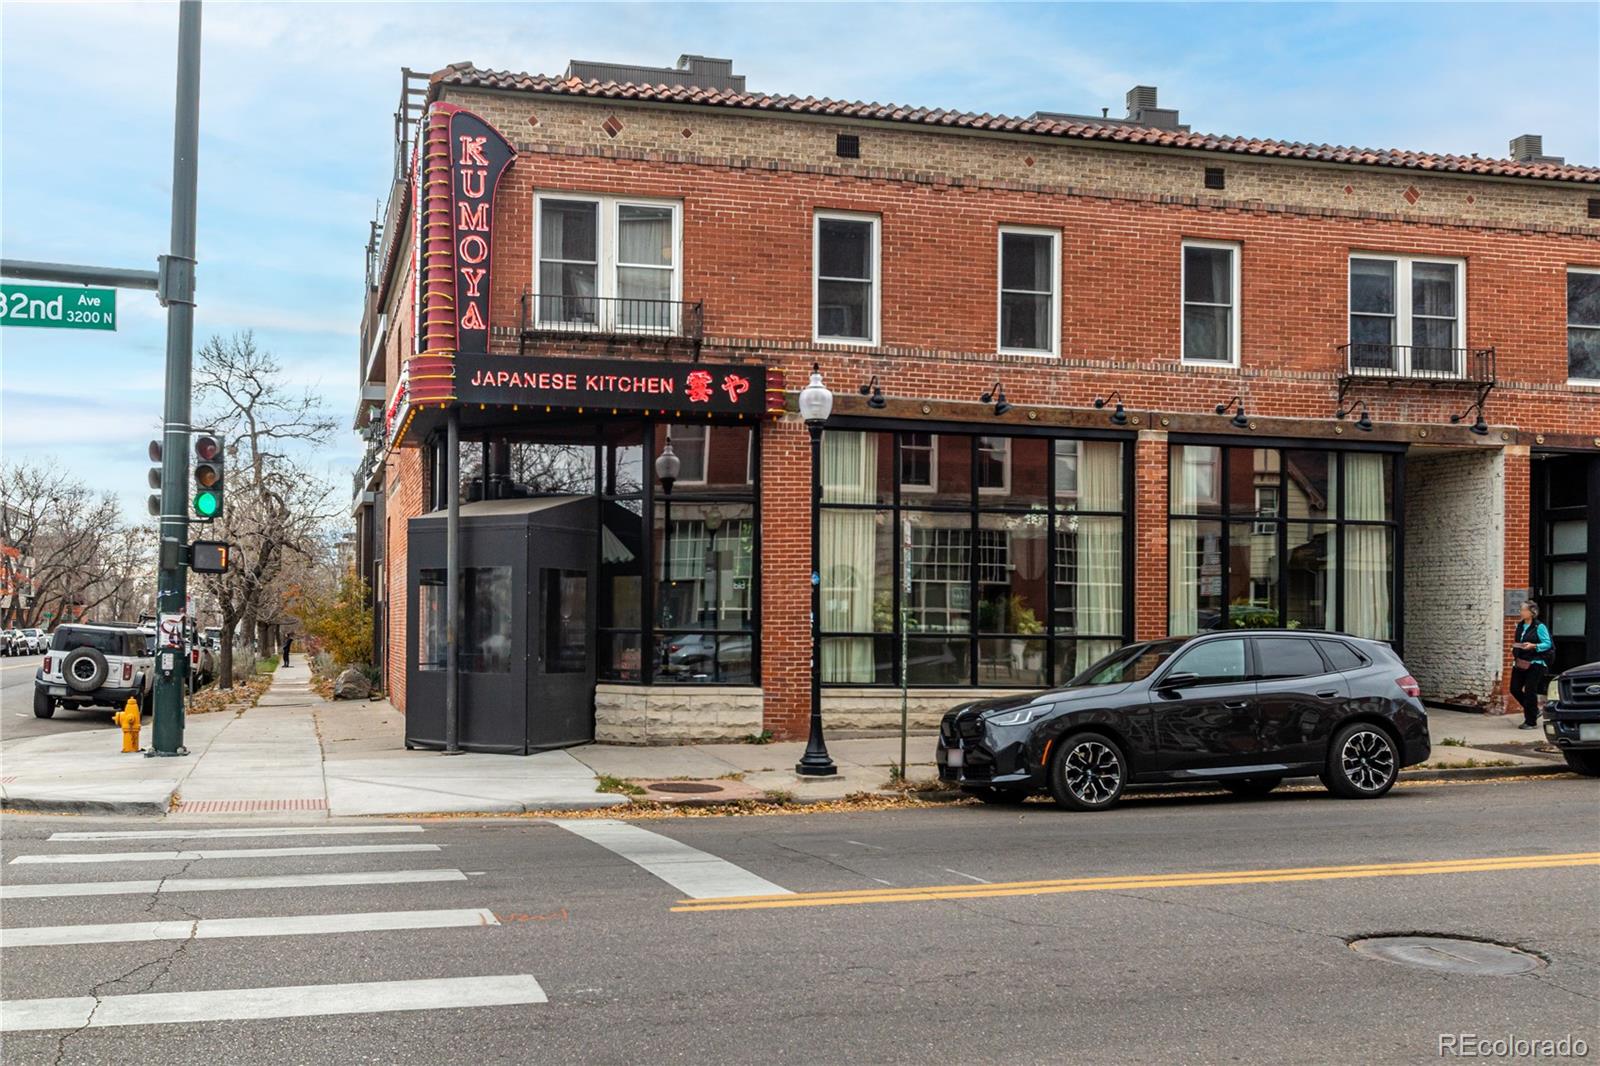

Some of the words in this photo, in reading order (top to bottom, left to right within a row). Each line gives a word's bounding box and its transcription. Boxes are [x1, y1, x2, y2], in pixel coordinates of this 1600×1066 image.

[458, 136, 490, 330] KUMOYA
[78, 294, 102, 307] Ave
[66, 310, 100, 324] 3200
[103, 312, 113, 324] N
[470, 370, 578, 391] JAPANESE
[585, 374, 674, 394] KITCHEN
